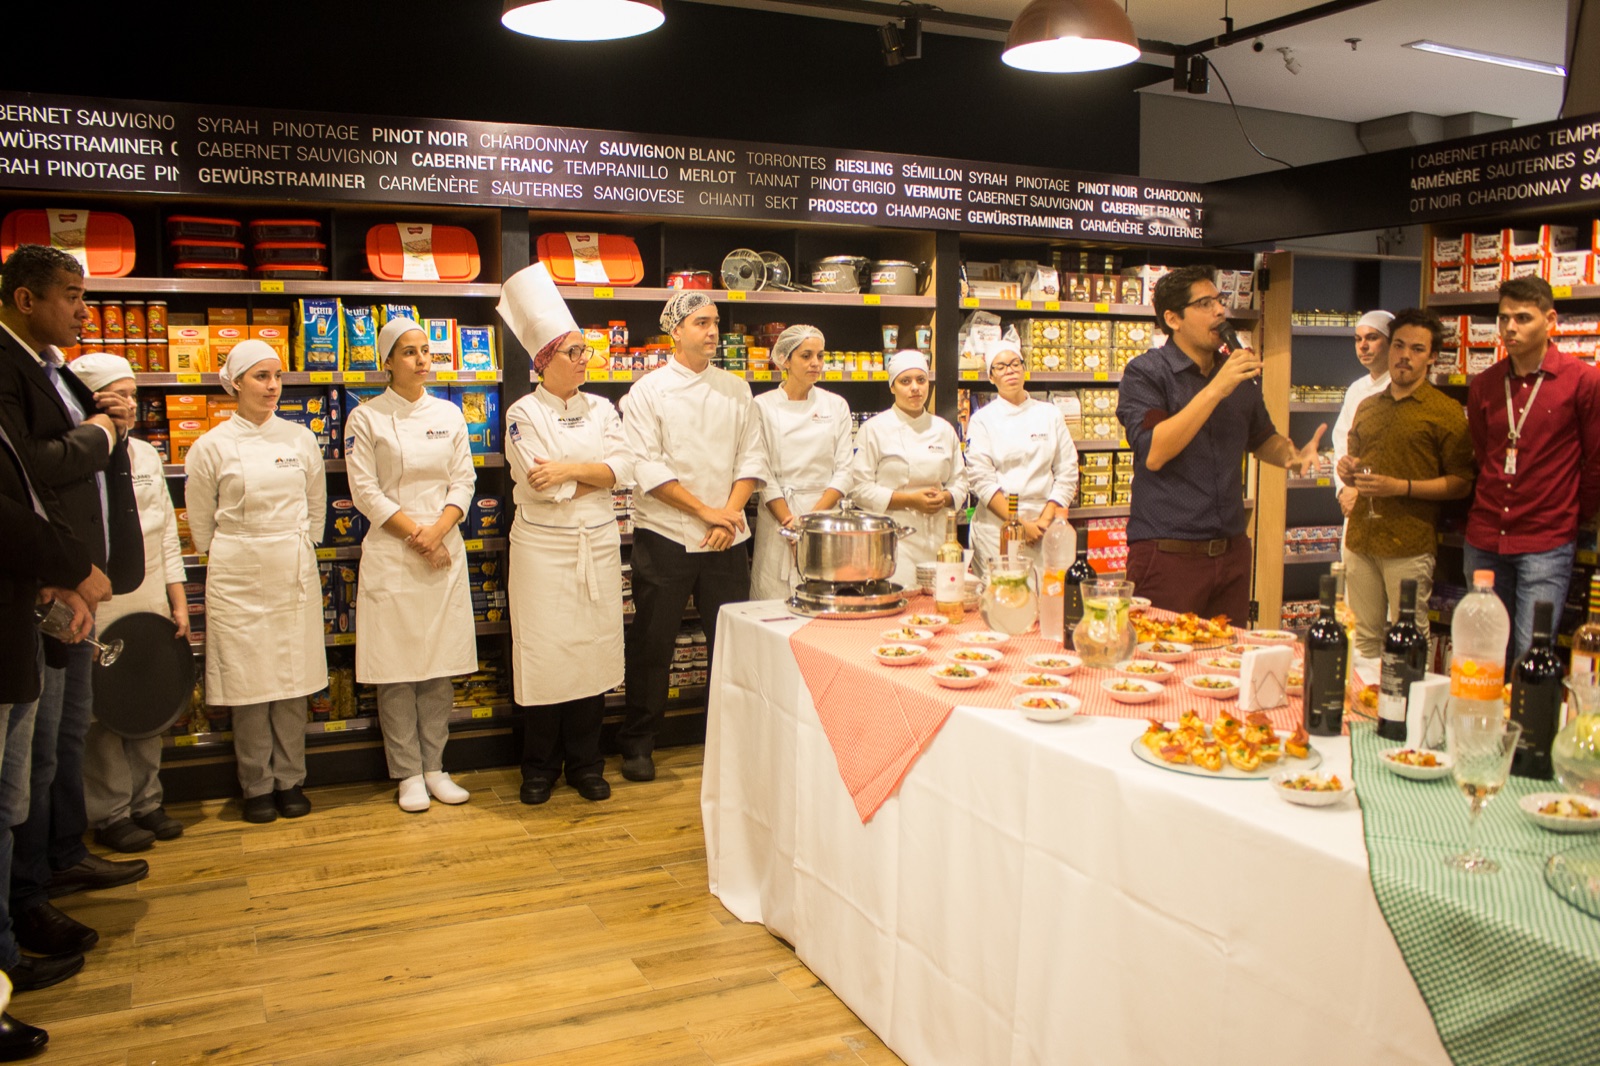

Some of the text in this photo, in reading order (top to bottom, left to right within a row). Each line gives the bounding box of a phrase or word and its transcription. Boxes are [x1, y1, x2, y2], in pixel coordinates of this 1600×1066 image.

[77, 109, 175, 130] SAUVIGNO
[197, 117, 259, 135] SYRAH
[273, 121, 359, 141] PINOTAGE
[372, 127, 424, 145] PINOT
[428, 130, 468, 148] NOIR
[479, 133, 589, 154] CHARDONNAY
[600, 140, 685, 160] SAUVIGNON
[689, 147, 736, 164] BLANC
[746, 151, 826, 171] TORRONTES
[835, 158, 893, 176] RIESLING
[902, 162, 963, 182] SÉMILLON
[968, 171, 1008, 186] SYRAH
[1015, 175, 1070, 192] PINOTAGE
[1077, 181, 1111, 196] PINOT
[1112, 184, 1138, 198] NOIR
[1418, 144, 1488, 169] CABERNET
[1491, 134, 1541, 156] FRANC
[1486, 151, 1576, 180] SAUTERNES
[47, 160, 146, 180] PINOTAGE
[197, 141, 289, 161] CABERNET
[296, 145, 398, 166] SAUVIGNON
[411, 151, 497, 171] CABERNET
[501, 156, 554, 174] FRANC
[563, 159, 669, 180] TEMPRANILLO
[679, 166, 736, 184] MERLOT
[746, 172, 800, 189] TANNAT
[810, 176, 850, 192] PINOT
[852, 179, 896, 195] GRIGIO
[904, 183, 963, 201] VERMUTE
[968, 190, 1028, 207] CABERNET
[1030, 194, 1094, 212] SAUVIGNON
[1101, 200, 1155, 217] CABERNET
[1157, 205, 1190, 220] FRANC
[198, 166, 366, 189] GEWÜRSTRAMINER
[378, 174, 479, 194] CARMÉNÈRE
[491, 180, 583, 199] SAUTERNES
[593, 186, 685, 204] SANGIOVESE
[699, 191, 755, 208] CHIANTI
[765, 195, 798, 210] SEKT
[808, 198, 878, 215] PROSECCO
[886, 203, 962, 221] CHAMPAGNE
[968, 209, 1073, 230] GEWÜRSTRAMINER
[1080, 218, 1143, 236] CARMÉNÈRE
[1429, 193, 1462, 210] NOIR
[1468, 177, 1571, 206] CHARDONNAY
